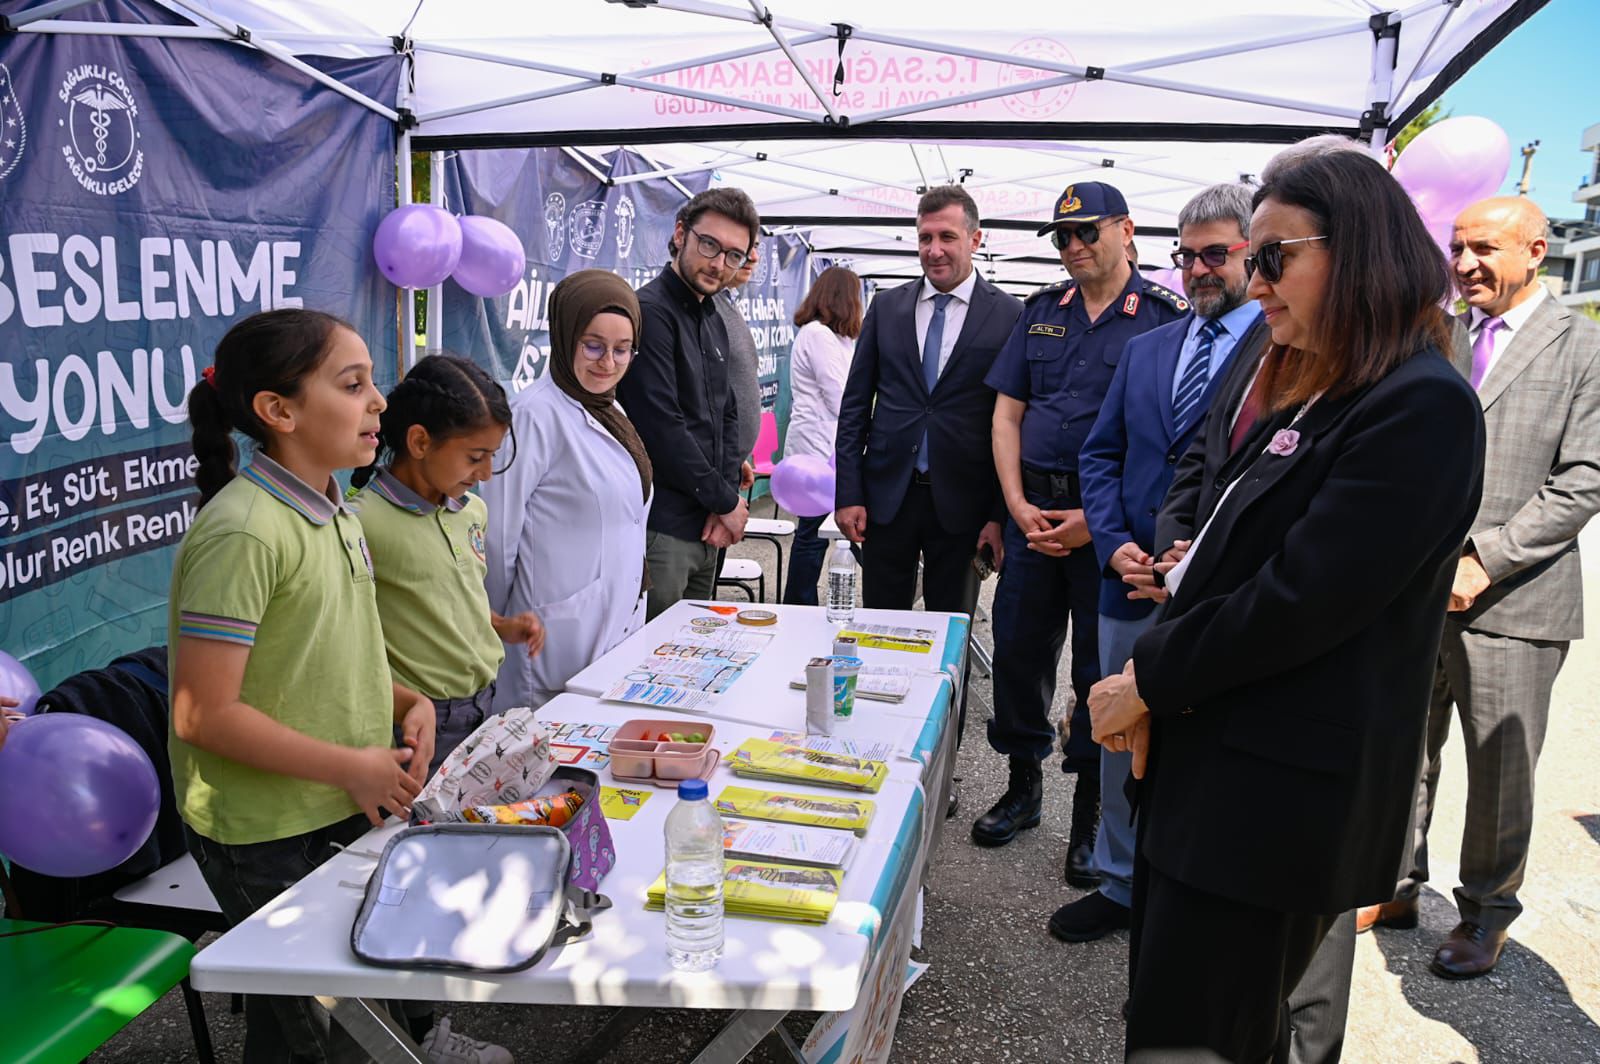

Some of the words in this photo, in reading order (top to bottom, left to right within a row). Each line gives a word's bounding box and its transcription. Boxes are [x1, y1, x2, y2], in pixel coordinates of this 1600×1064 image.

[58, 64, 107, 104] SAĞLIKLI
[107, 71, 139, 118] ÇOCUK
[62, 144, 107, 196] SAĞLIKLI
[1037, 325, 1054, 333] ALTIN
[25, 481, 60, 520] Et,
[63, 465, 119, 504] Süt,
[51, 520, 123, 573] Renk
